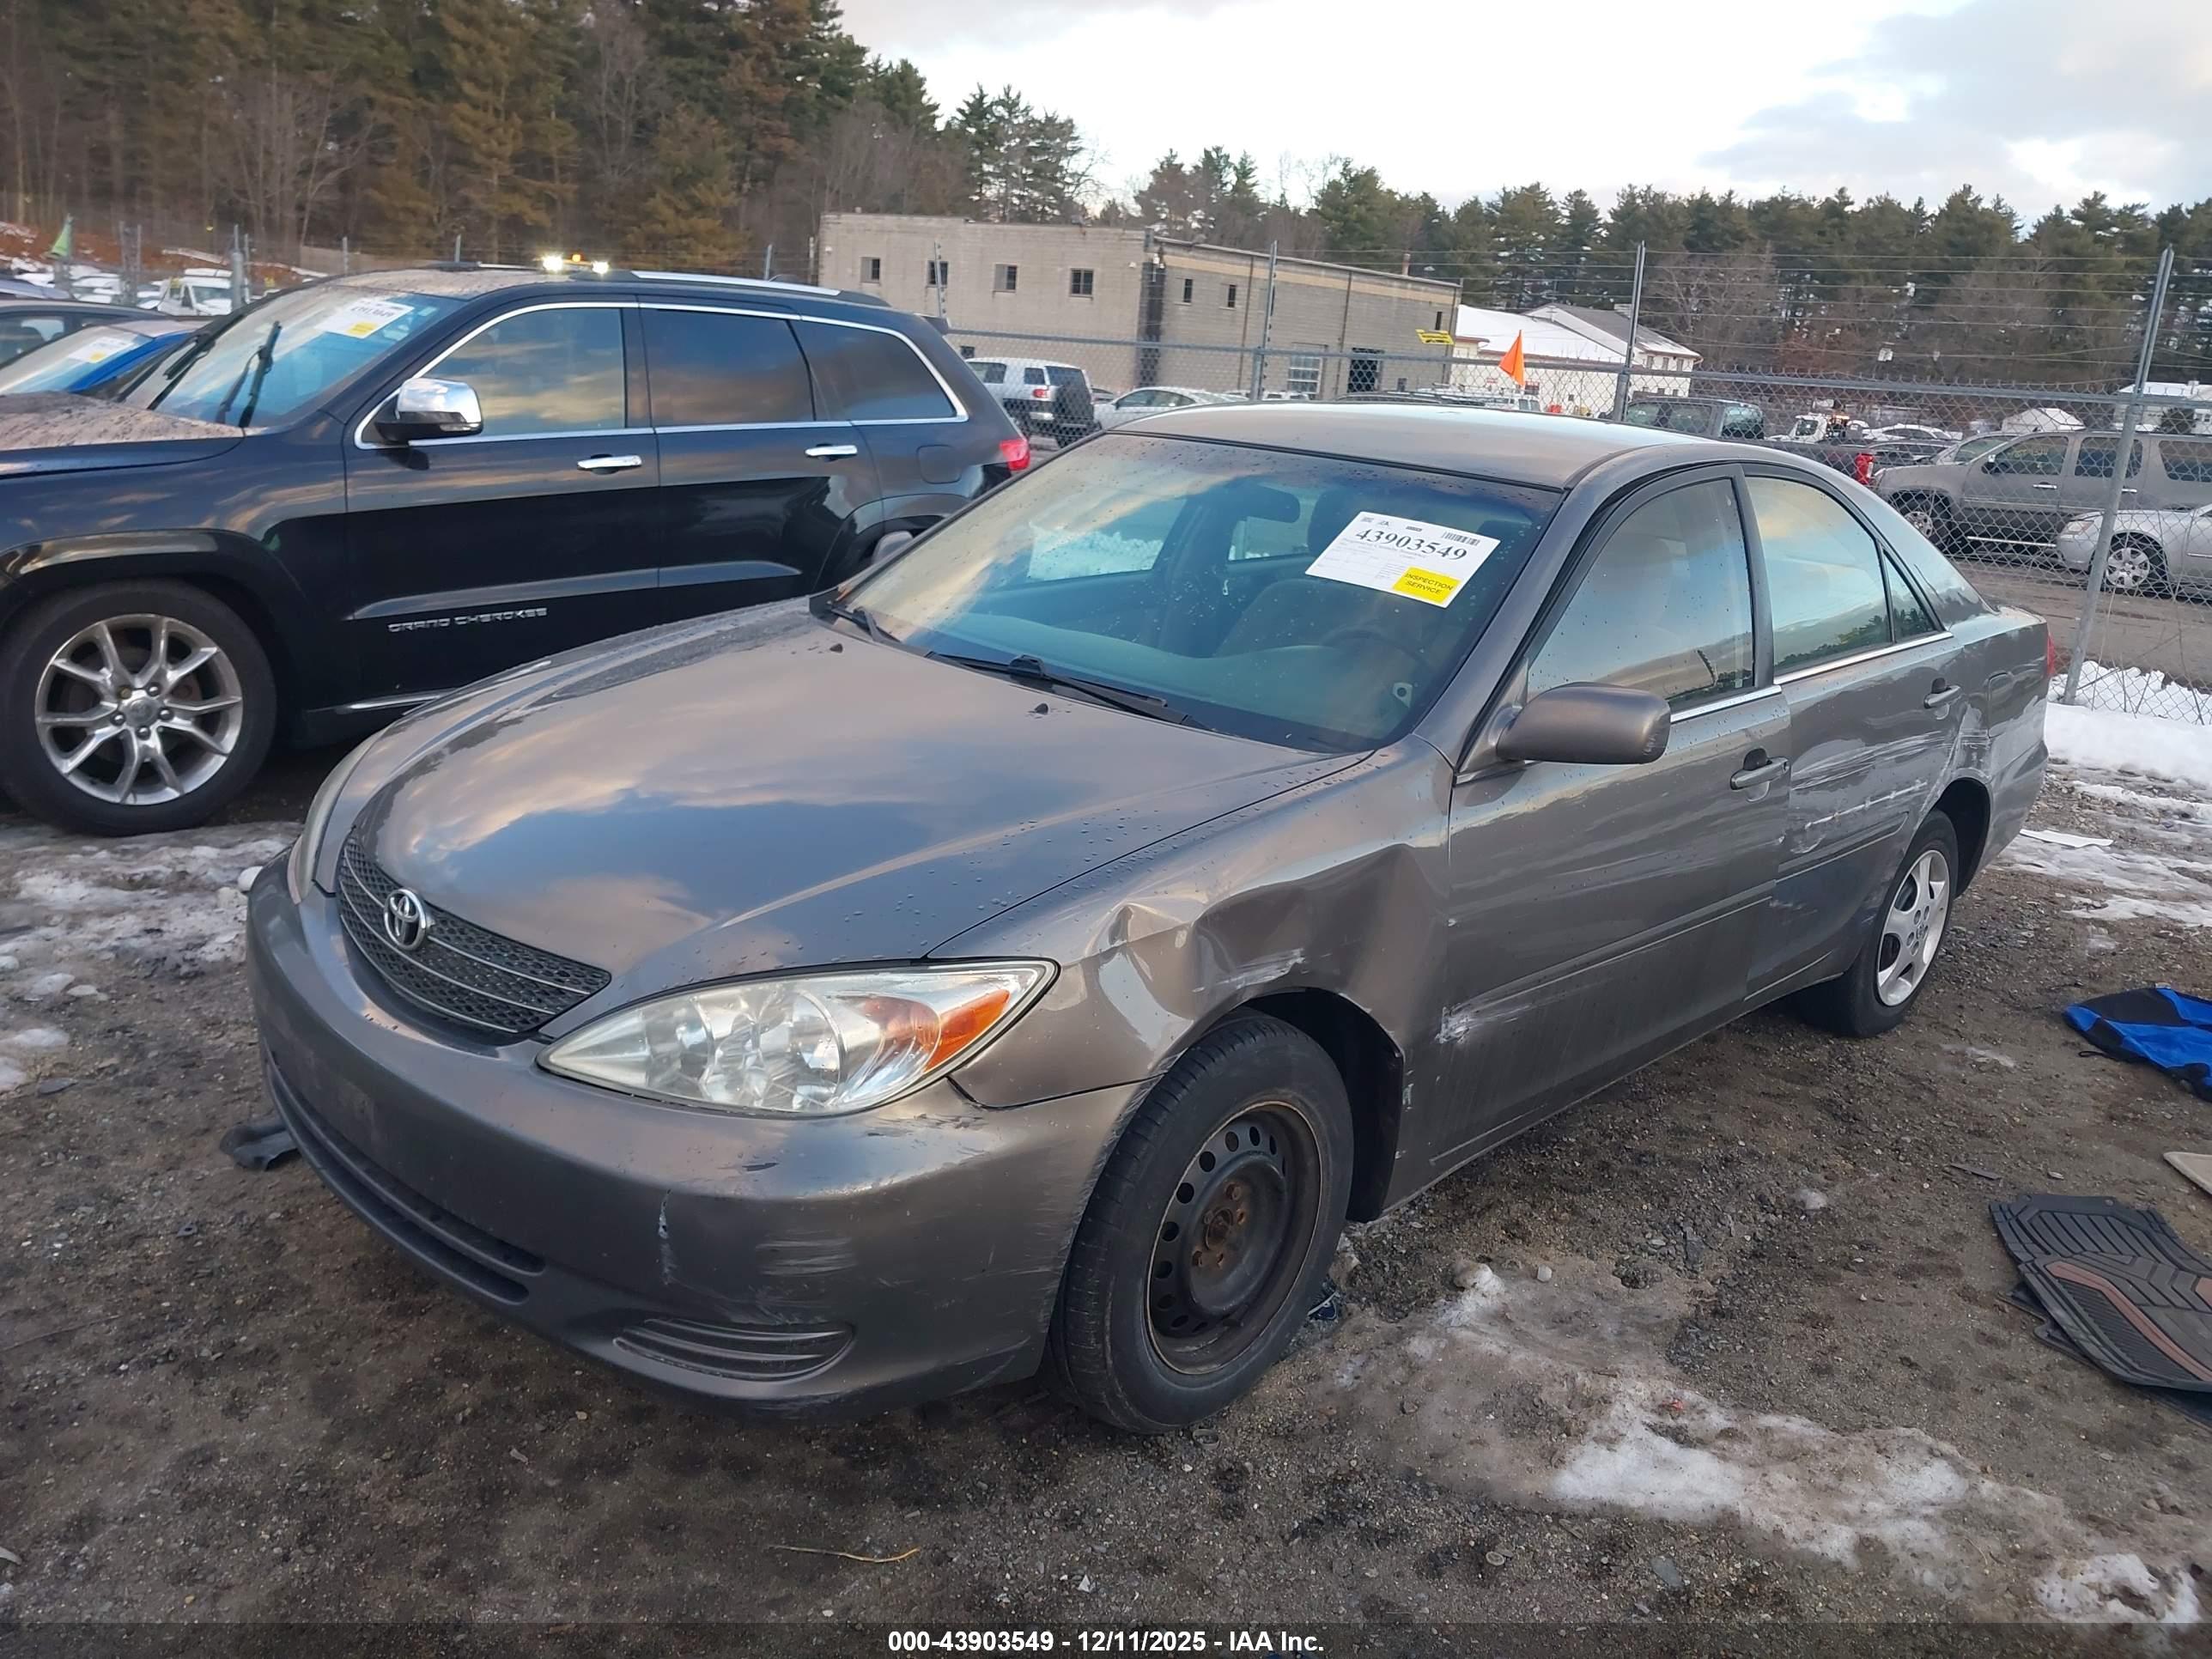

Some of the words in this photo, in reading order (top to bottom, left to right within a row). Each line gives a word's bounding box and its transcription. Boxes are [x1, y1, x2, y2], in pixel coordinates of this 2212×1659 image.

[1355, 528, 1468, 561] 43903549
[1404, 573, 1454, 591] INSPECTION
[1406, 580, 1443, 594] SERVICE
[388, 617, 451, 633] GRAND
[453, 607, 548, 625] CHEROKEE
